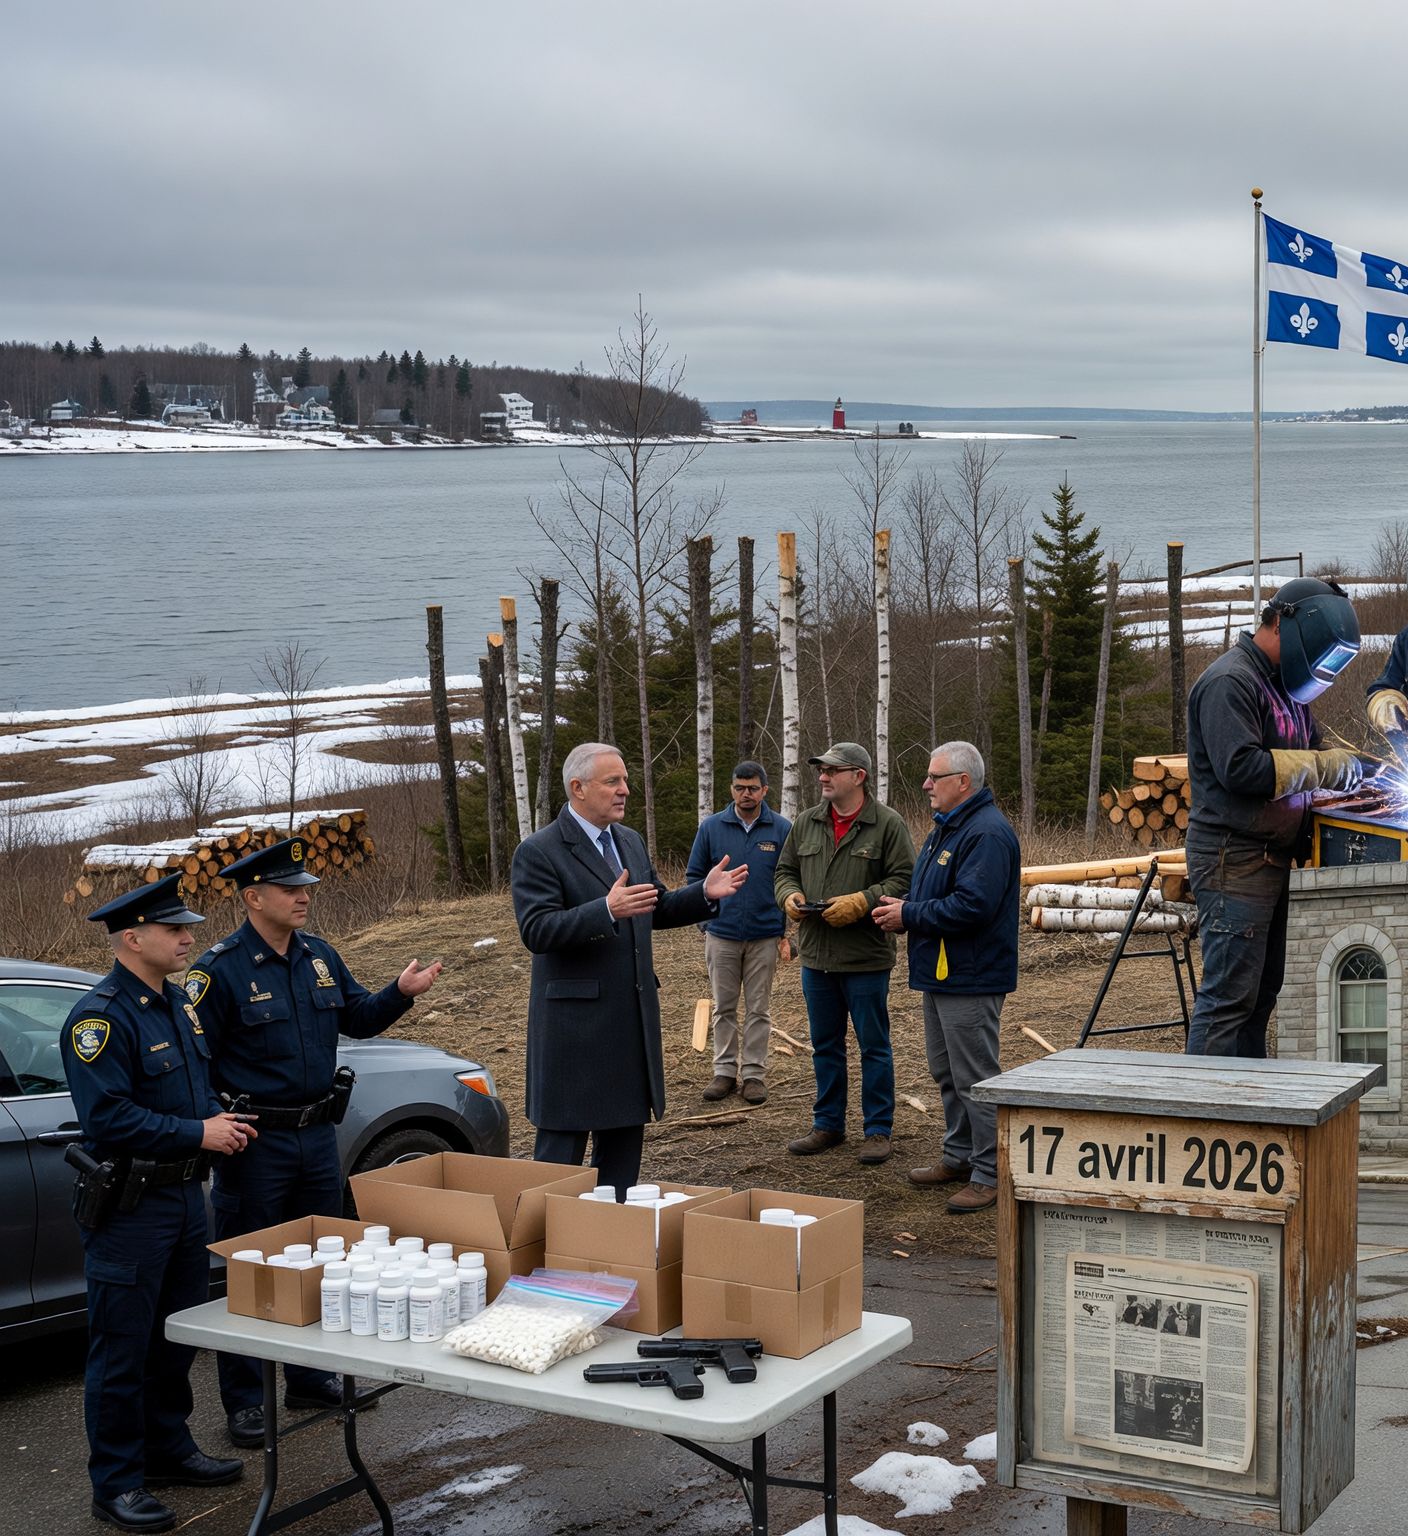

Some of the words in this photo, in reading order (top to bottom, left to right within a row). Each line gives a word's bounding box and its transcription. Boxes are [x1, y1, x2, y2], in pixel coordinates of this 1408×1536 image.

[1018, 1124, 1065, 1176] 17
[1078, 1132, 1167, 1185] avril
[1182, 1136, 1285, 1196] 2026
